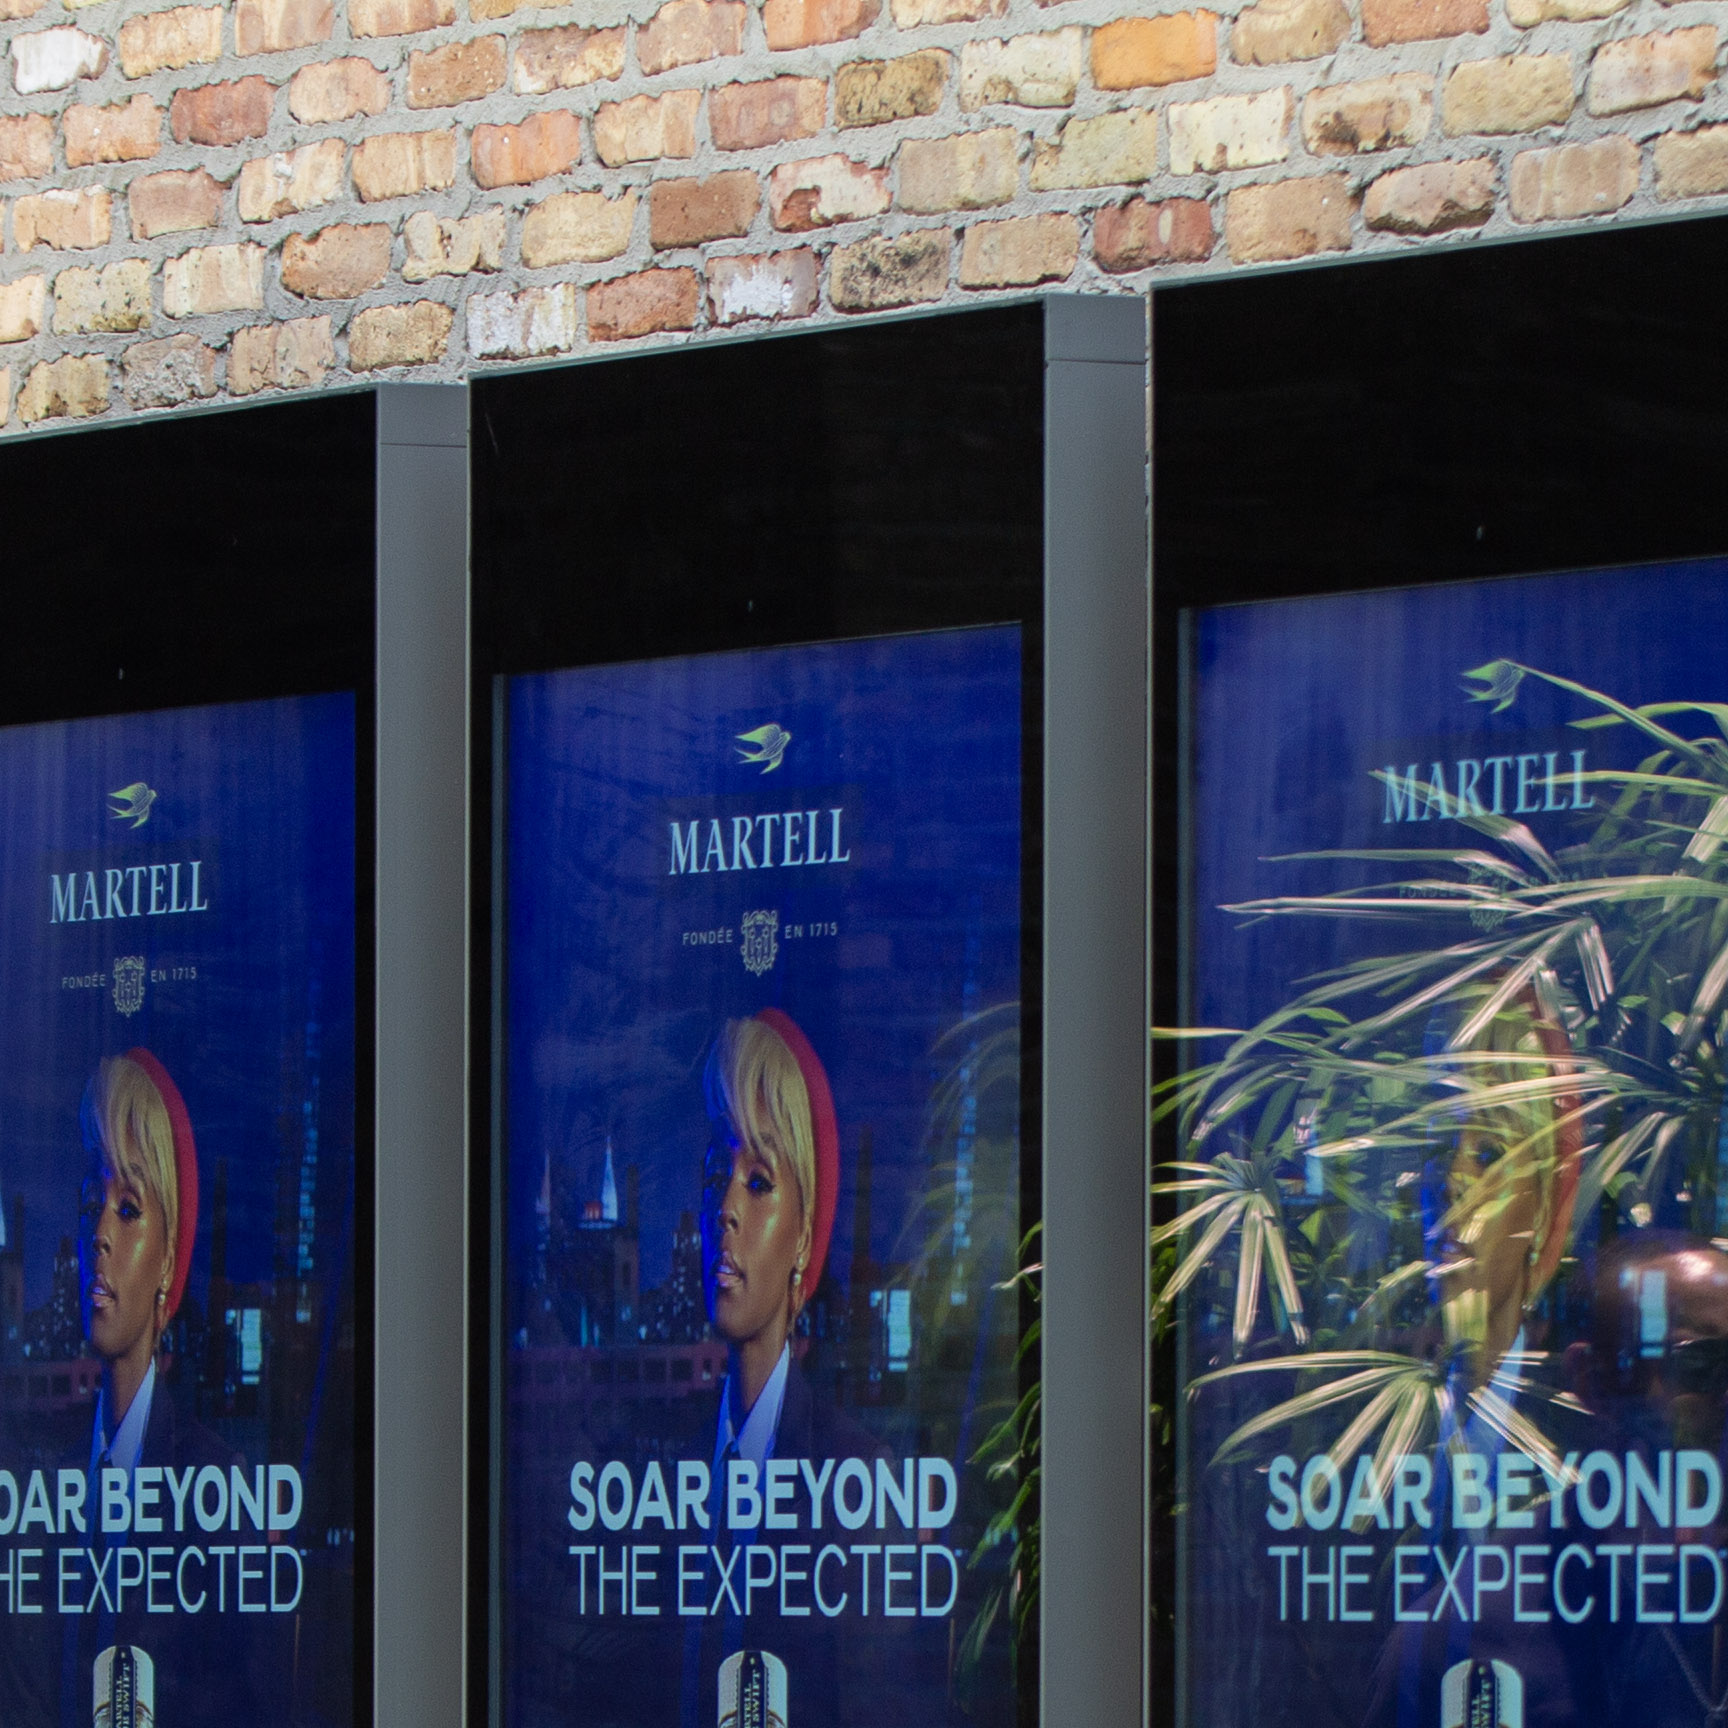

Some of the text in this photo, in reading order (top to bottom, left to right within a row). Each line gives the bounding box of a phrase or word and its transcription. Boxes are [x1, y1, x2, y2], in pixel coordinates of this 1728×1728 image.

[1382, 750, 1597, 824] MARTELL
[669, 808, 850, 875] MARTELL
[49, 860, 208, 923] MARTELL
[682, 923, 838, 945] FONDÉE EN 1715
[151, 969, 167, 983] EN
[171, 966, 197, 981] 1715
[101, 1464, 303, 1533] BEYOND
[568, 1457, 958, 1531] SOAR BEYOND
[1266, 1450, 1724, 1531] SOAR BEYOND
[58, 1545, 304, 1614] EXPECTED
[568, 1544, 958, 1617] THE EXPECTED
[1267, 1544, 1725, 1624] THE EXPECTED
